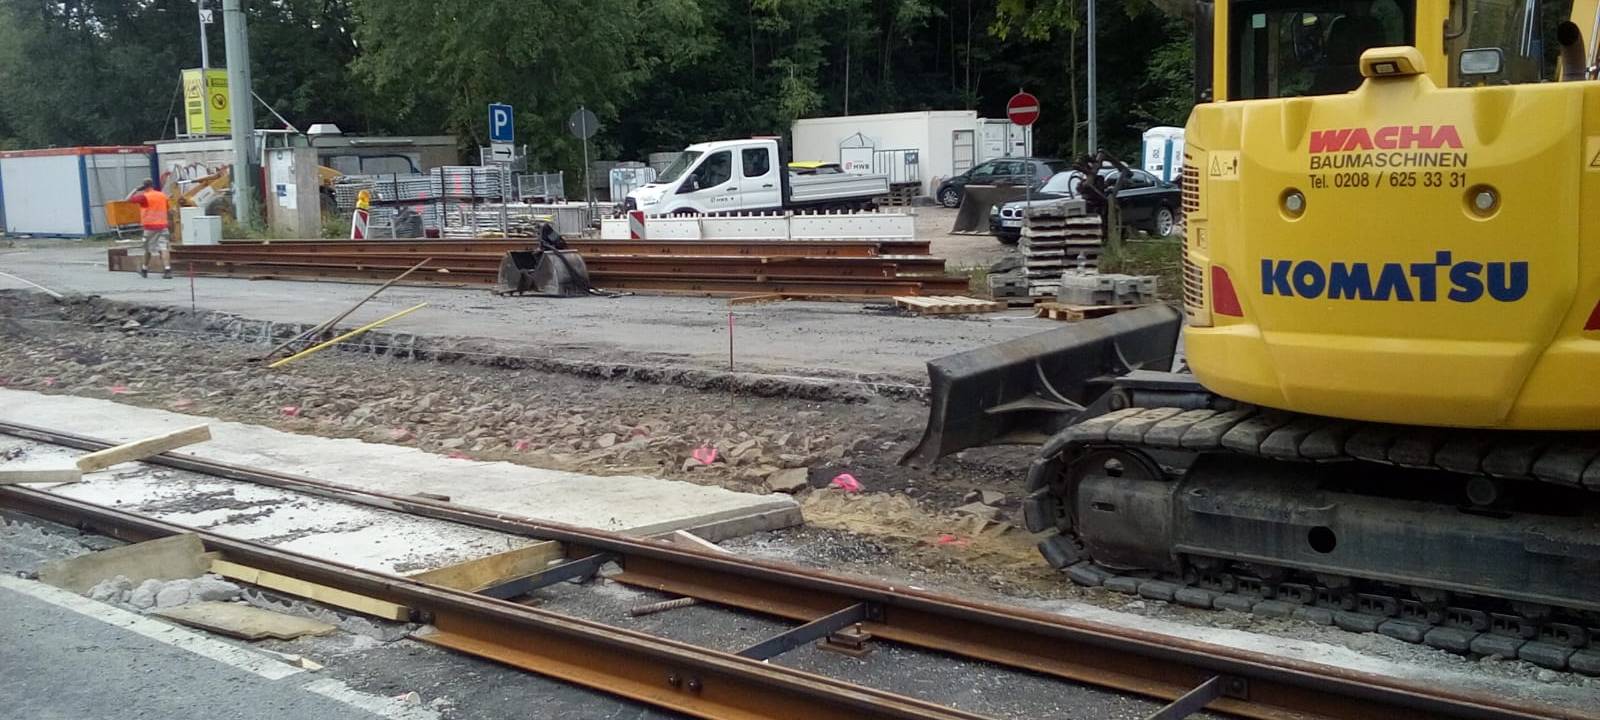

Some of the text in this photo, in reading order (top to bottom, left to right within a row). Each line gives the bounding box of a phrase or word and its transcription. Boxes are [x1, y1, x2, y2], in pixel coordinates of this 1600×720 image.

[494, 109, 507, 136] P
[1309, 125, 1463, 153] WACHA
[1310, 152, 1468, 170] BAUMASCHINEN
[1309, 171, 1466, 189] Tel. 0208 / 625 33 31
[1261, 251, 1529, 303] KOMATSU
